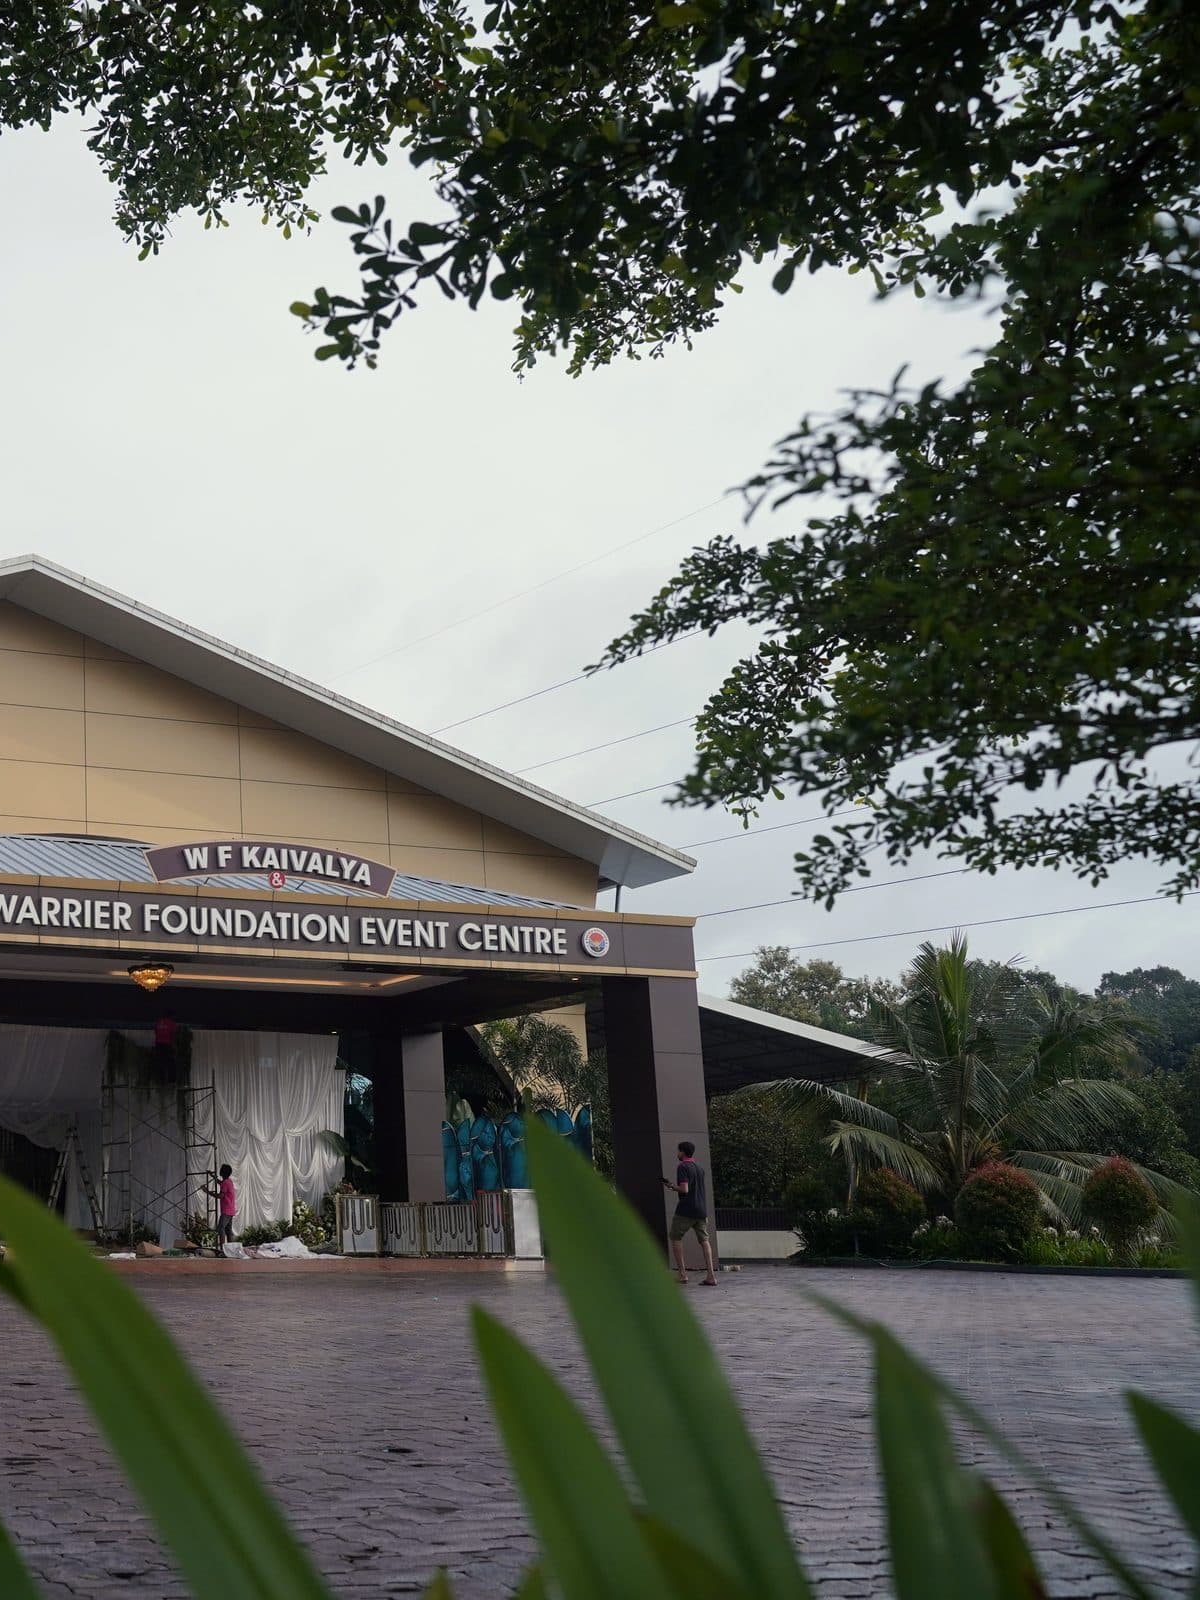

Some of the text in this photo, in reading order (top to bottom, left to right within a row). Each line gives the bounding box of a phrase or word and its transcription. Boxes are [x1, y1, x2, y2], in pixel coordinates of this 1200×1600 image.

[184, 845, 371, 886] W F KAIVALYA
[271, 872, 284, 886] &
[143, 903, 349, 943] FOUNDATION
[360, 916, 449, 949] EVENT
[457, 922, 568, 955] CENTRE
